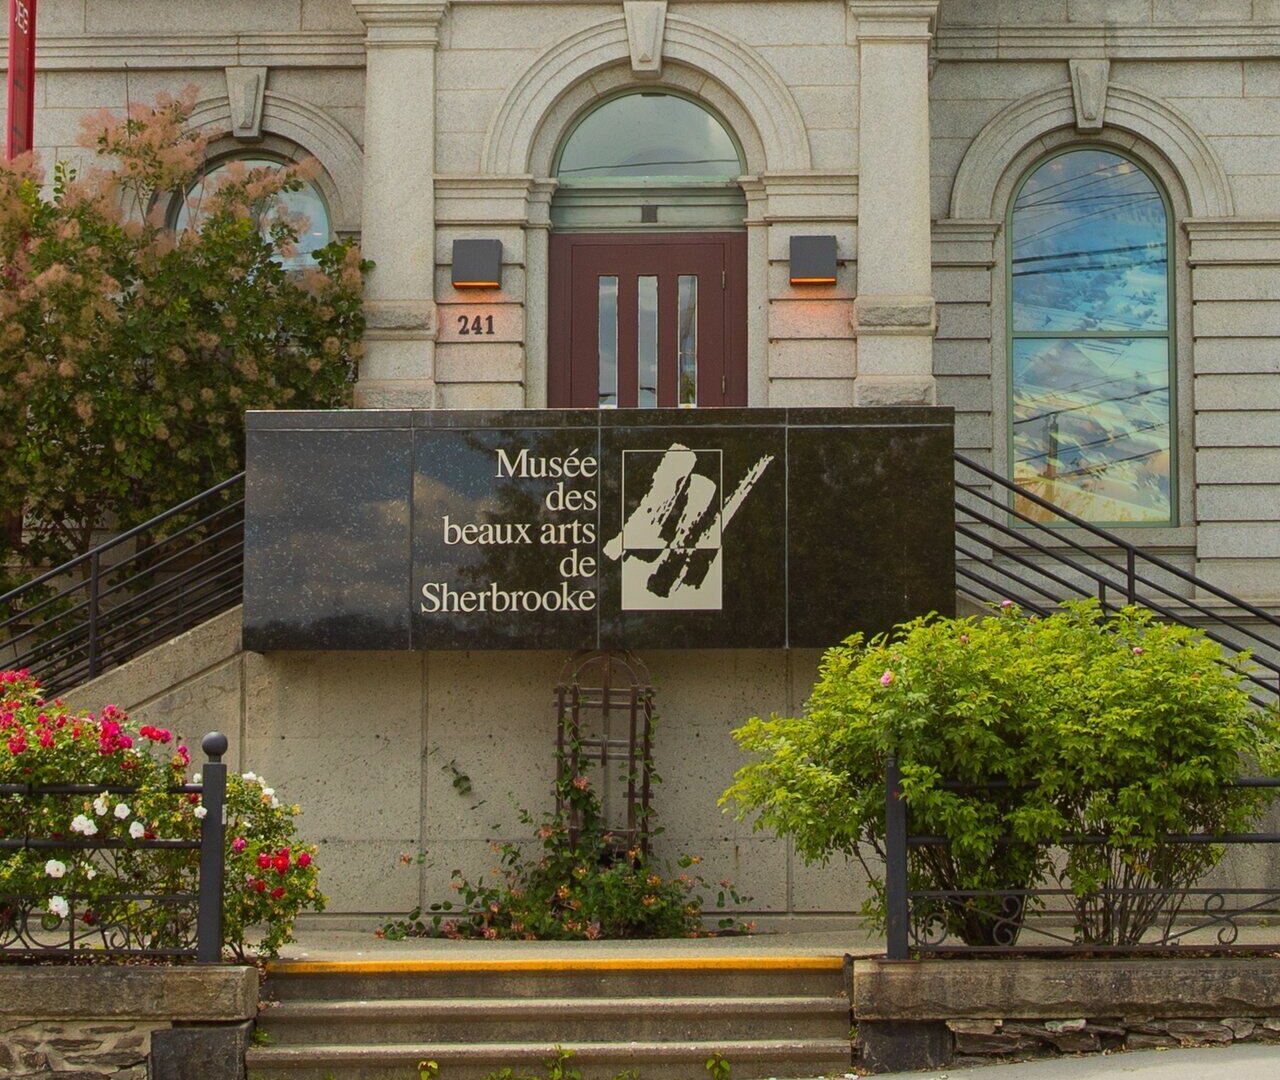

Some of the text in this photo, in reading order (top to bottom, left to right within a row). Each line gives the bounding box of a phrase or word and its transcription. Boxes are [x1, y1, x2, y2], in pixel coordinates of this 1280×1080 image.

[457, 315, 495, 335] 241
[496, 449, 597, 477] Musée
[546, 482, 596, 510] des
[442, 516, 595, 544] beaux arts
[560, 549, 595, 577] de
[421, 582, 595, 612] Sherbrooke
